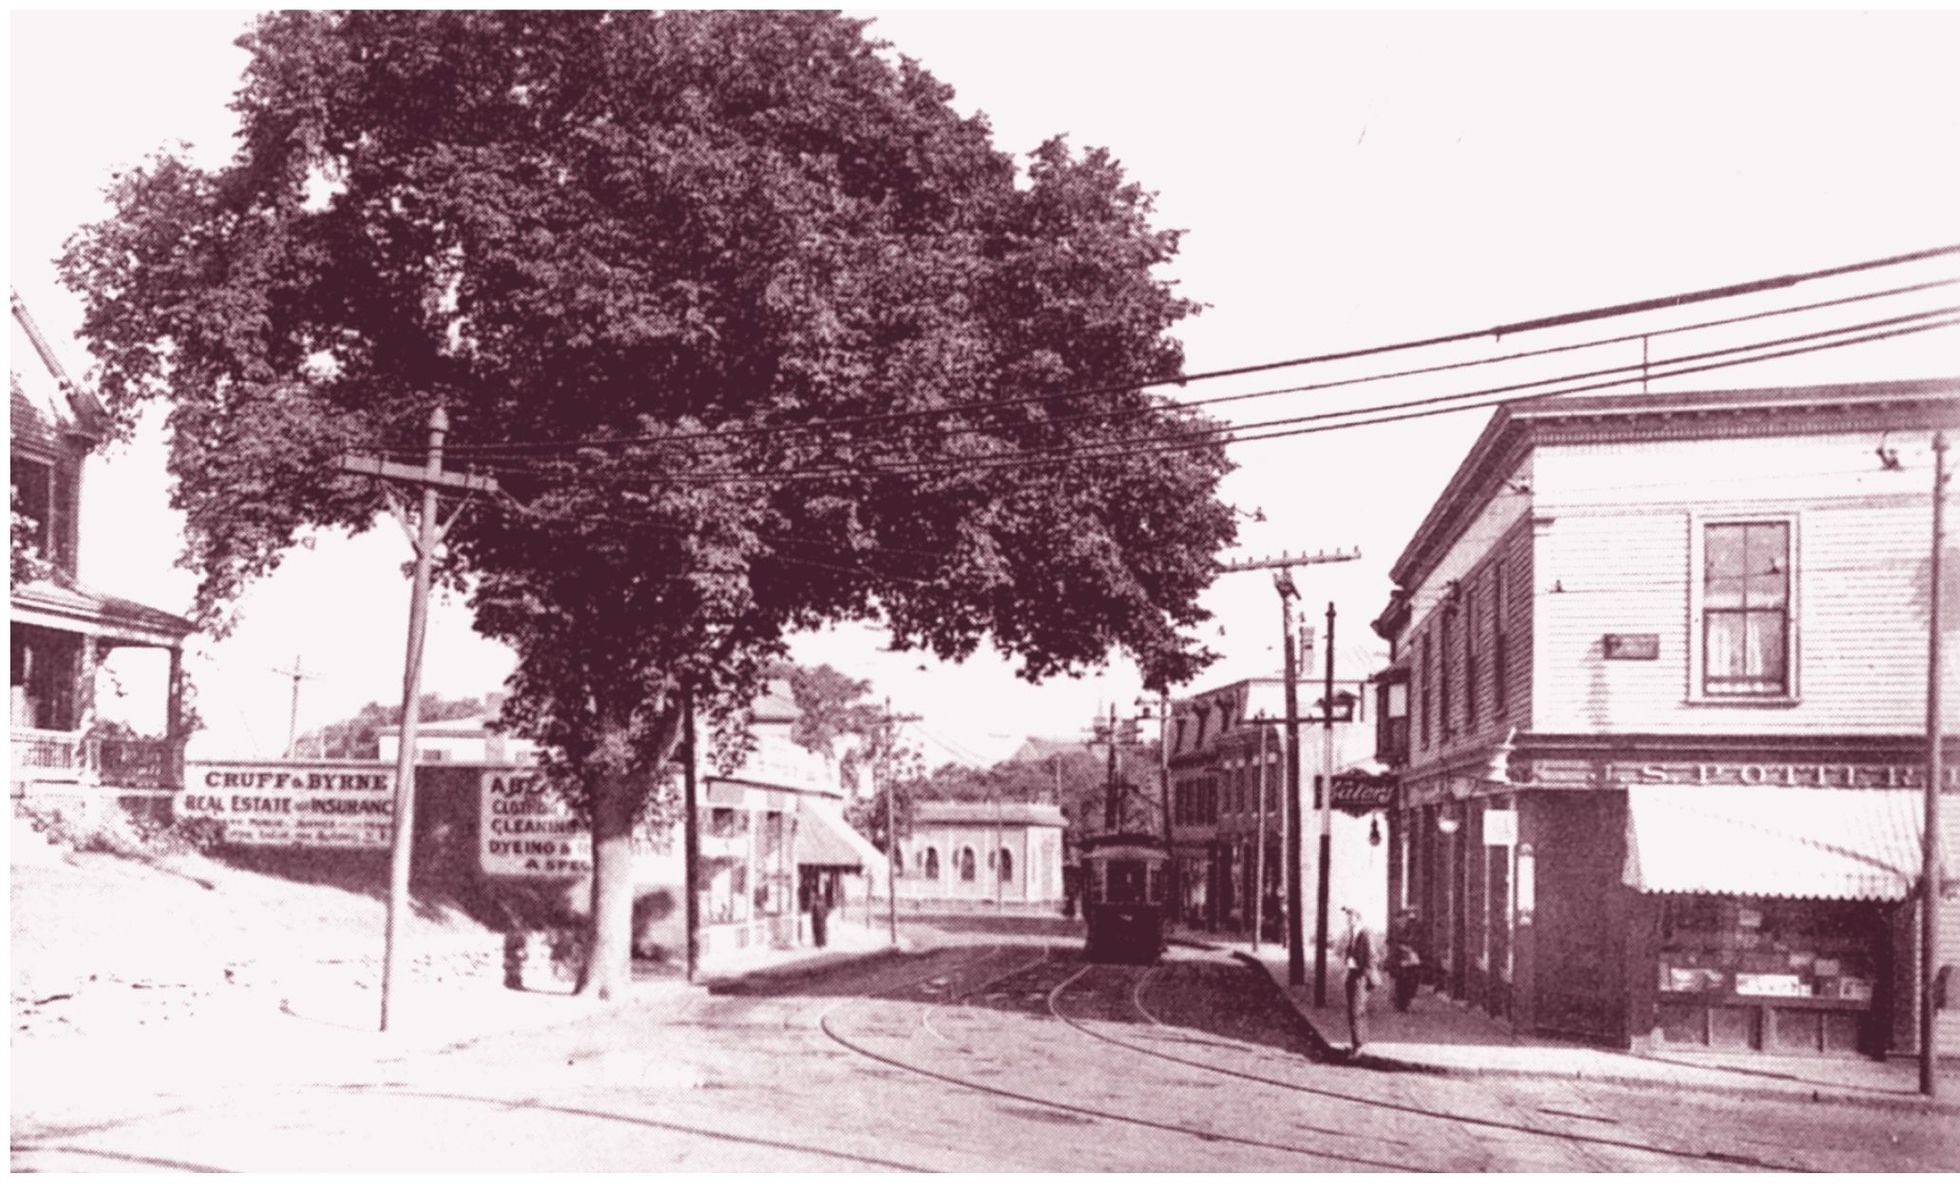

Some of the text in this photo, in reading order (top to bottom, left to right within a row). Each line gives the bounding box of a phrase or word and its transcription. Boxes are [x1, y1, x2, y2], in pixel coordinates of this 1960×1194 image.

[205, 771, 290, 788] CRUFF
[306, 774, 388, 790] BYRNE
[184, 795, 225, 813] REAL
[231, 796, 291, 813] ESTATE
[489, 840, 556, 855] DYEING
[525, 859, 540, 870] A
